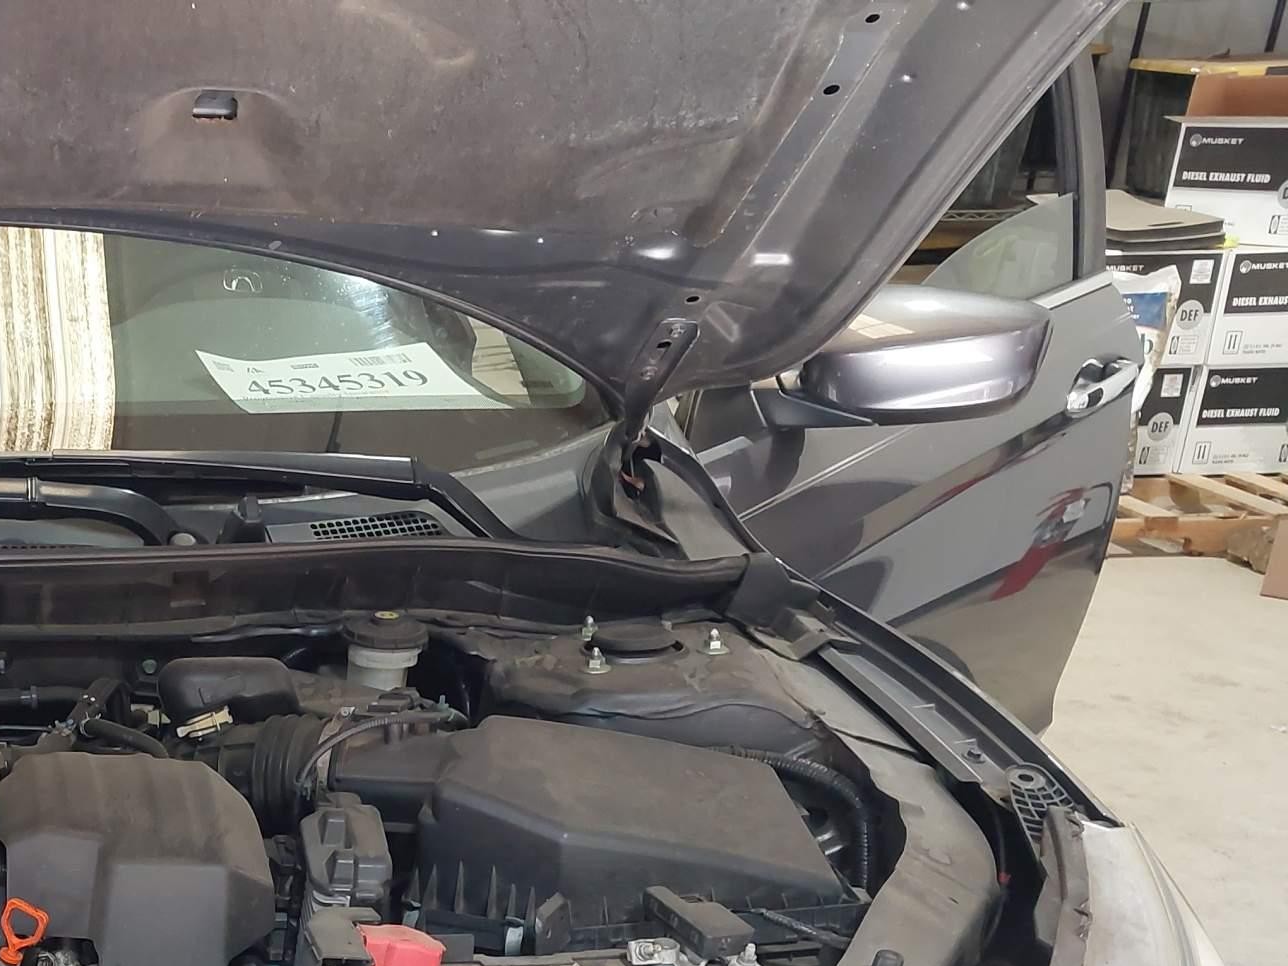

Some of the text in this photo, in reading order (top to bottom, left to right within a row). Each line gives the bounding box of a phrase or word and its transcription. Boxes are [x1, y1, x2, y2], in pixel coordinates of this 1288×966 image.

[1201, 137, 1245, 145] MUSKET
[1181, 170, 1271, 183] DIESEL EXHAUST FLUID
[1232, 297, 1257, 307] DIESEL
[1180, 309, 1199, 322] DEF
[248, 369, 428, 396] 45345319
[1220, 376, 1258, 385] MUSKET
[1202, 407, 1280, 419] DIESEL EXHAUST FLUID
[1151, 420, 1170, 433] DEF
